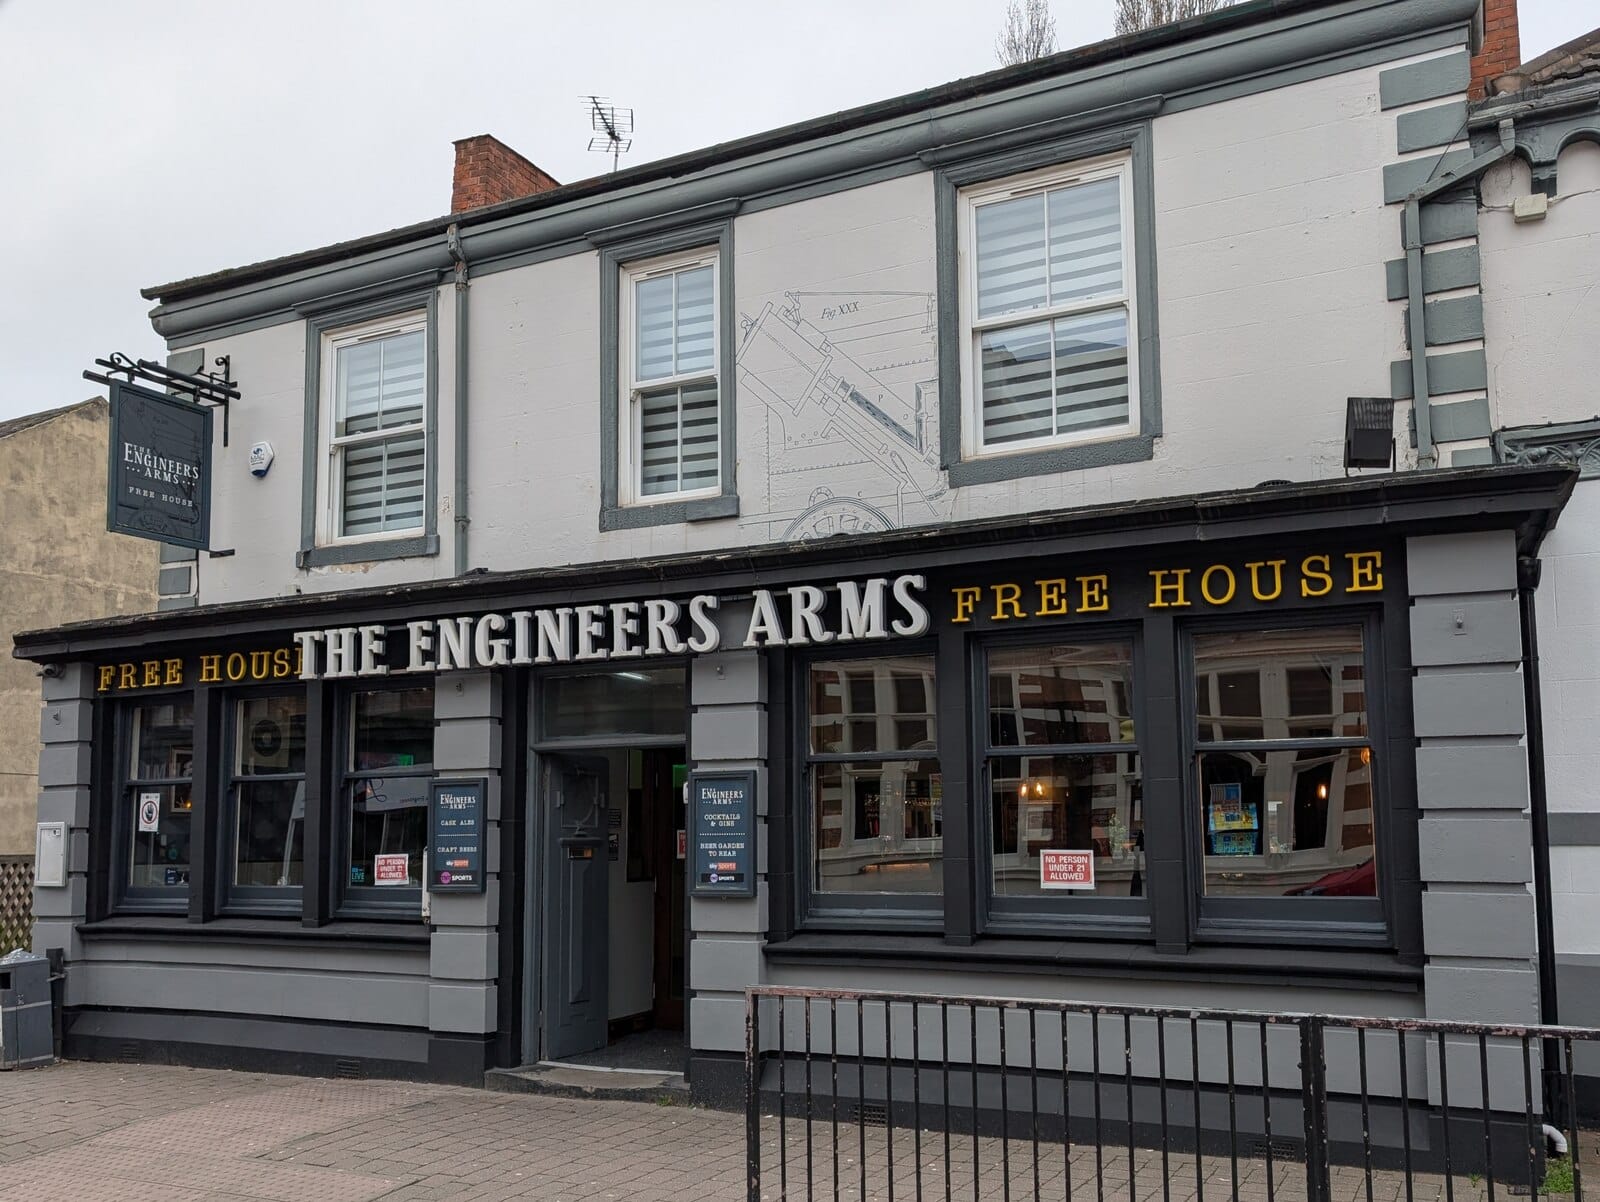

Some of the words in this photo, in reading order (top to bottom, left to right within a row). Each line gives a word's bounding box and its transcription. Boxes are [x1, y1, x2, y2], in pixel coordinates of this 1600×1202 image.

[124, 442, 199, 479] ENGINEERS
[144, 467, 179, 484] ARMS
[129, 486, 156, 498] FREE
[162, 494, 193, 507] HOUSE
[952, 574, 1110, 623] FREE
[1148, 550, 1384, 608] HOUSE
[293, 623, 391, 680] THE
[406, 594, 722, 673] ENGINEERS
[742, 574, 929, 648] ARMS
[97, 658, 184, 691] FREE
[440, 794, 477, 805] ENGINEERS
[702, 788, 744, 800] ENGINEERS
[1045, 855, 1056, 864] NO
[1059, 855, 1088, 864] PERSON
[1048, 864, 1073, 872] UNDER
[1076, 864, 1085, 872] 21
[1050, 872, 1084, 881] ALLOWED
